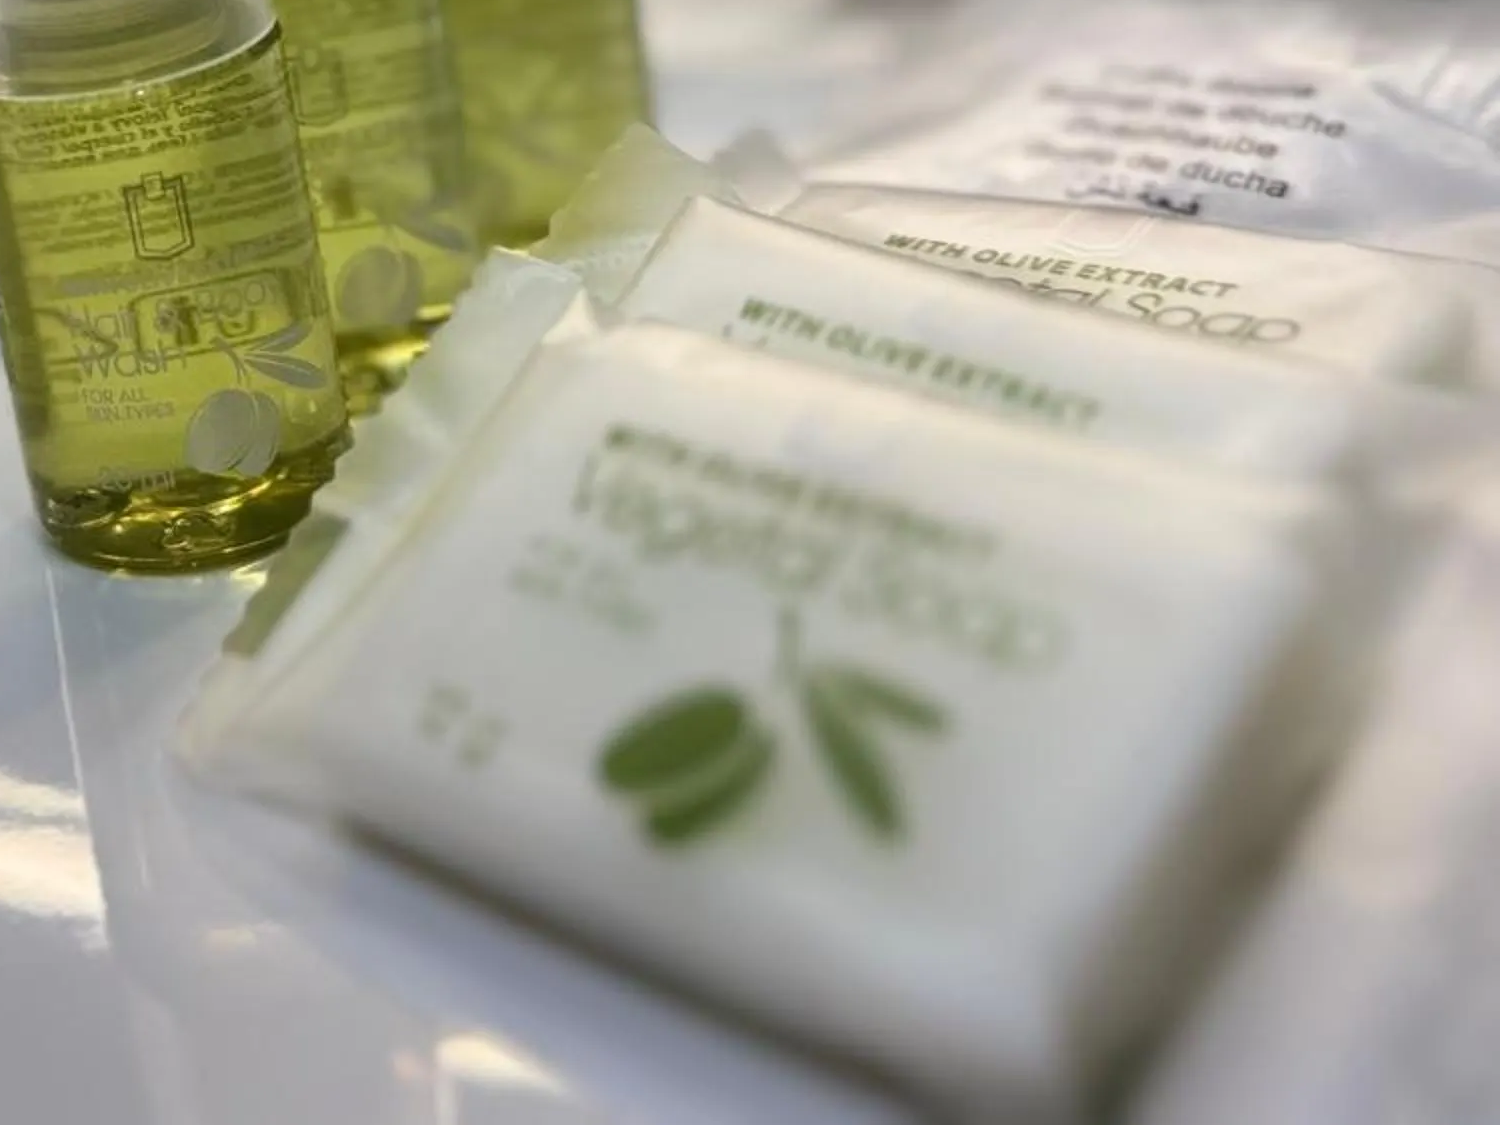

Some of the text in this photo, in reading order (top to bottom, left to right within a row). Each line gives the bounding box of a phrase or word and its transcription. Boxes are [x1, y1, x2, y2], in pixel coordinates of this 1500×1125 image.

[1179, 160, 1290, 199] ducha
[884, 233, 968, 259] WITH
[972, 248, 1077, 277] OLIVE
[1077, 262, 1240, 299] EXTRACT
[1126, 290, 1301, 347] Soap
[738, 295, 825, 343] WITH
[825, 323, 929, 375] OLIVE
[930, 355, 1101, 432] EXTRACT
[81, 386, 149, 405] FOR ALL
